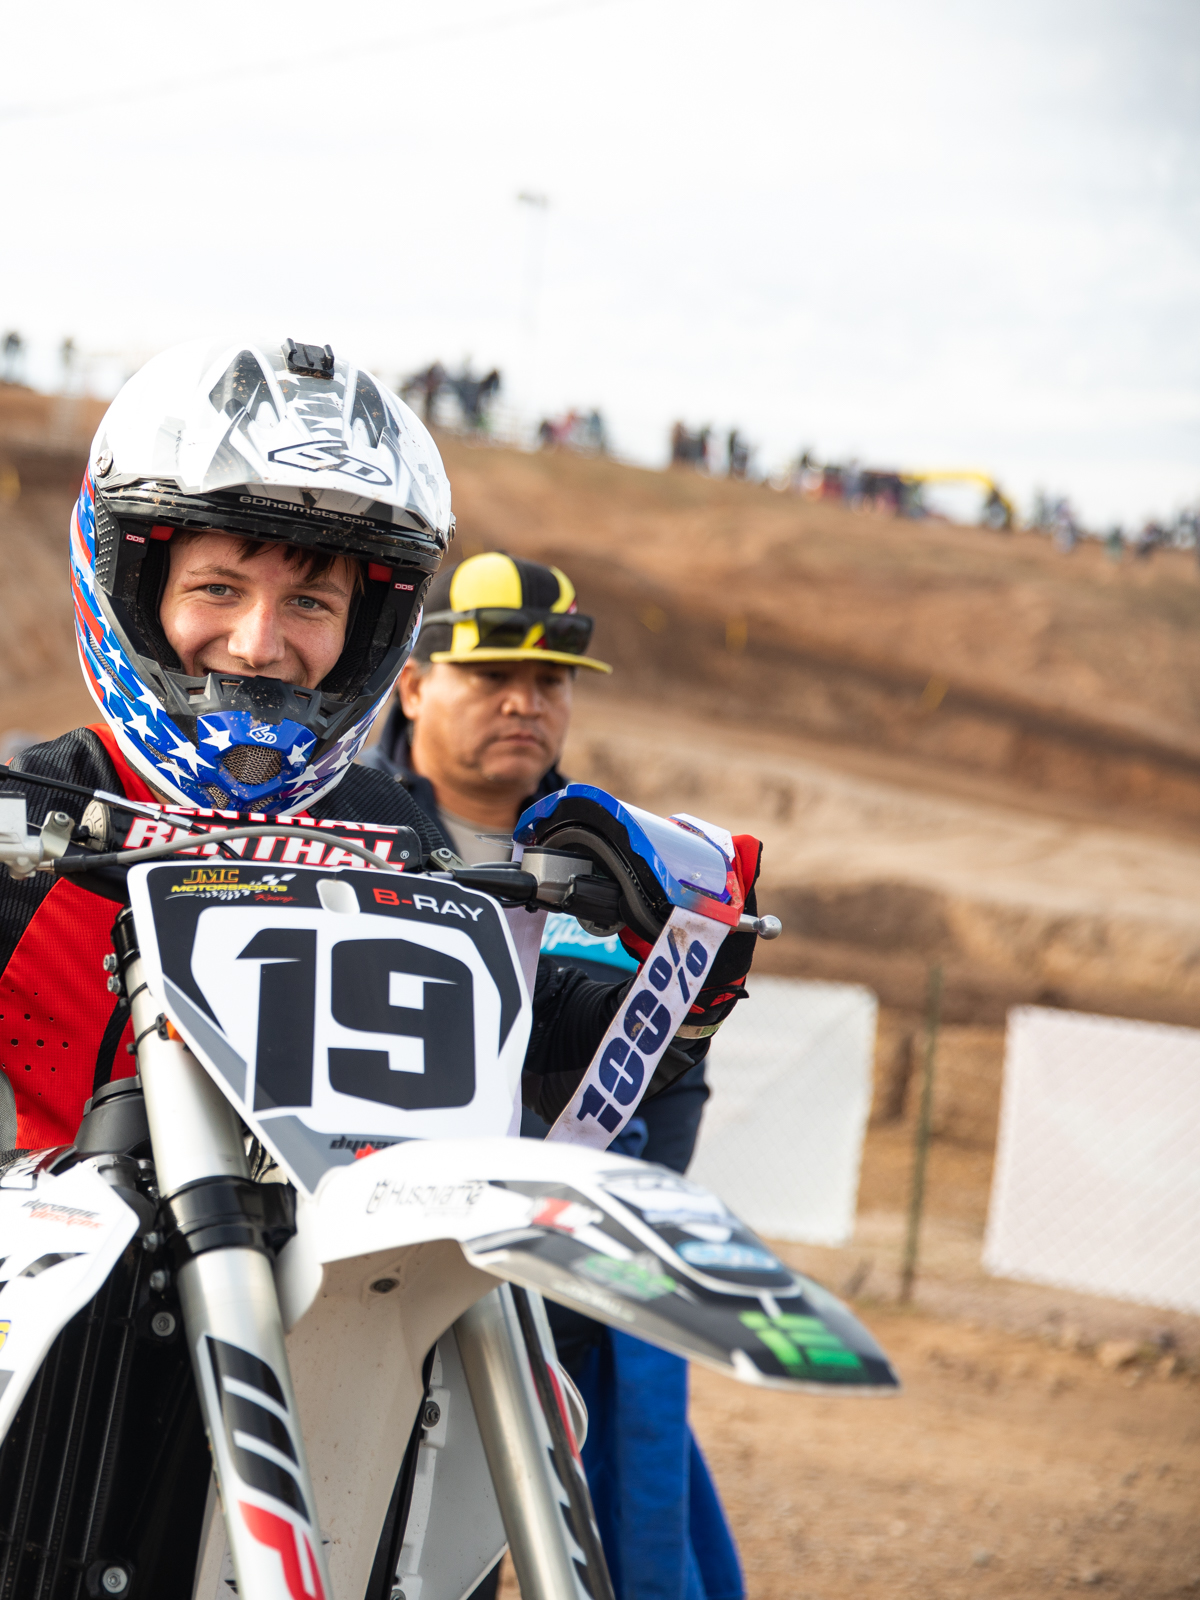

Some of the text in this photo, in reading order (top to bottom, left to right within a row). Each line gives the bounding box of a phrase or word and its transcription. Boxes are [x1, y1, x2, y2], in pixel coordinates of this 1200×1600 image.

[239, 495, 376, 527] 6Dhelmets.com
[394, 583, 414, 591] ODS
[171, 884, 288, 893] MOTORSPORTS
[183, 869, 240, 884] JMC
[372, 888, 484, 922] B-RAY
[235, 928, 476, 1111] 19
[576, 929, 708, 1134] 100%
